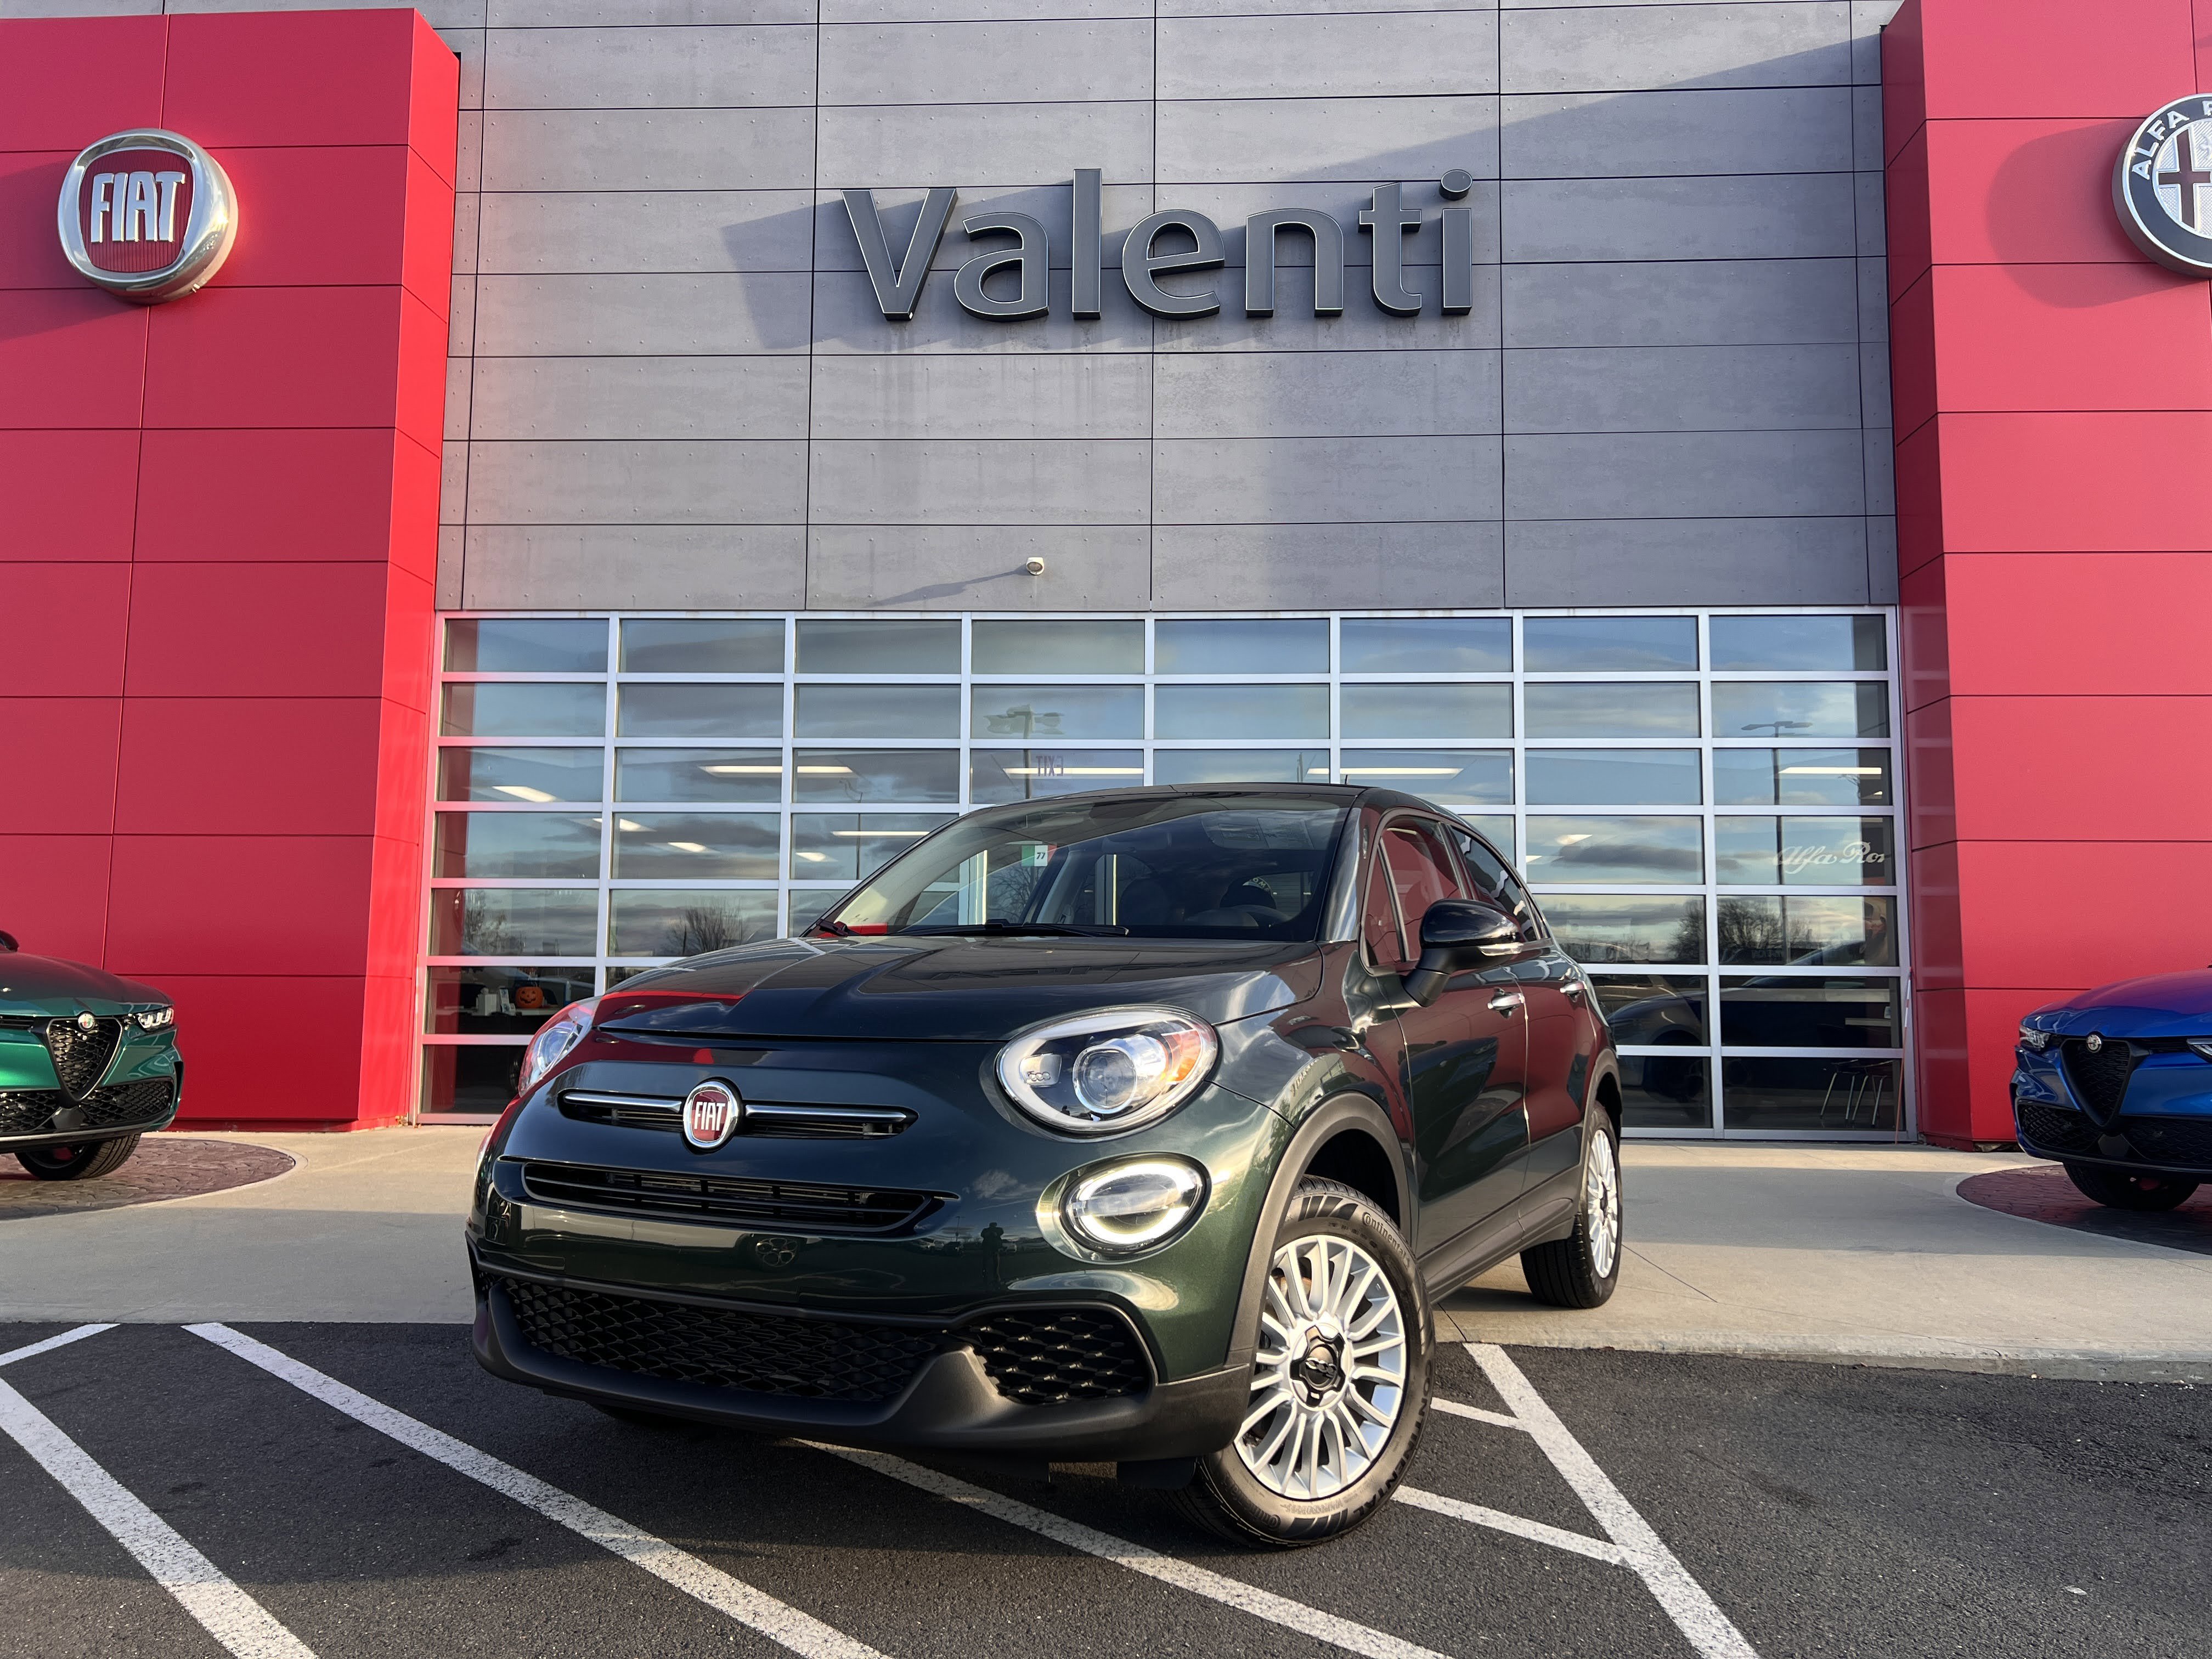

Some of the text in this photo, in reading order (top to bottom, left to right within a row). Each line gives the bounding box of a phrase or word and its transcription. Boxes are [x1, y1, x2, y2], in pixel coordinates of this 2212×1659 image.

[2132, 111, 2190, 180] ALFA
[91, 171, 185, 243] FIAT
[841, 168, 1473, 323] Valenti
[694, 1101, 726, 1131] FIAT
[1362, 1211, 1407, 1259] Continental
[1353, 1359, 1432, 1517] CONTINENTAL
